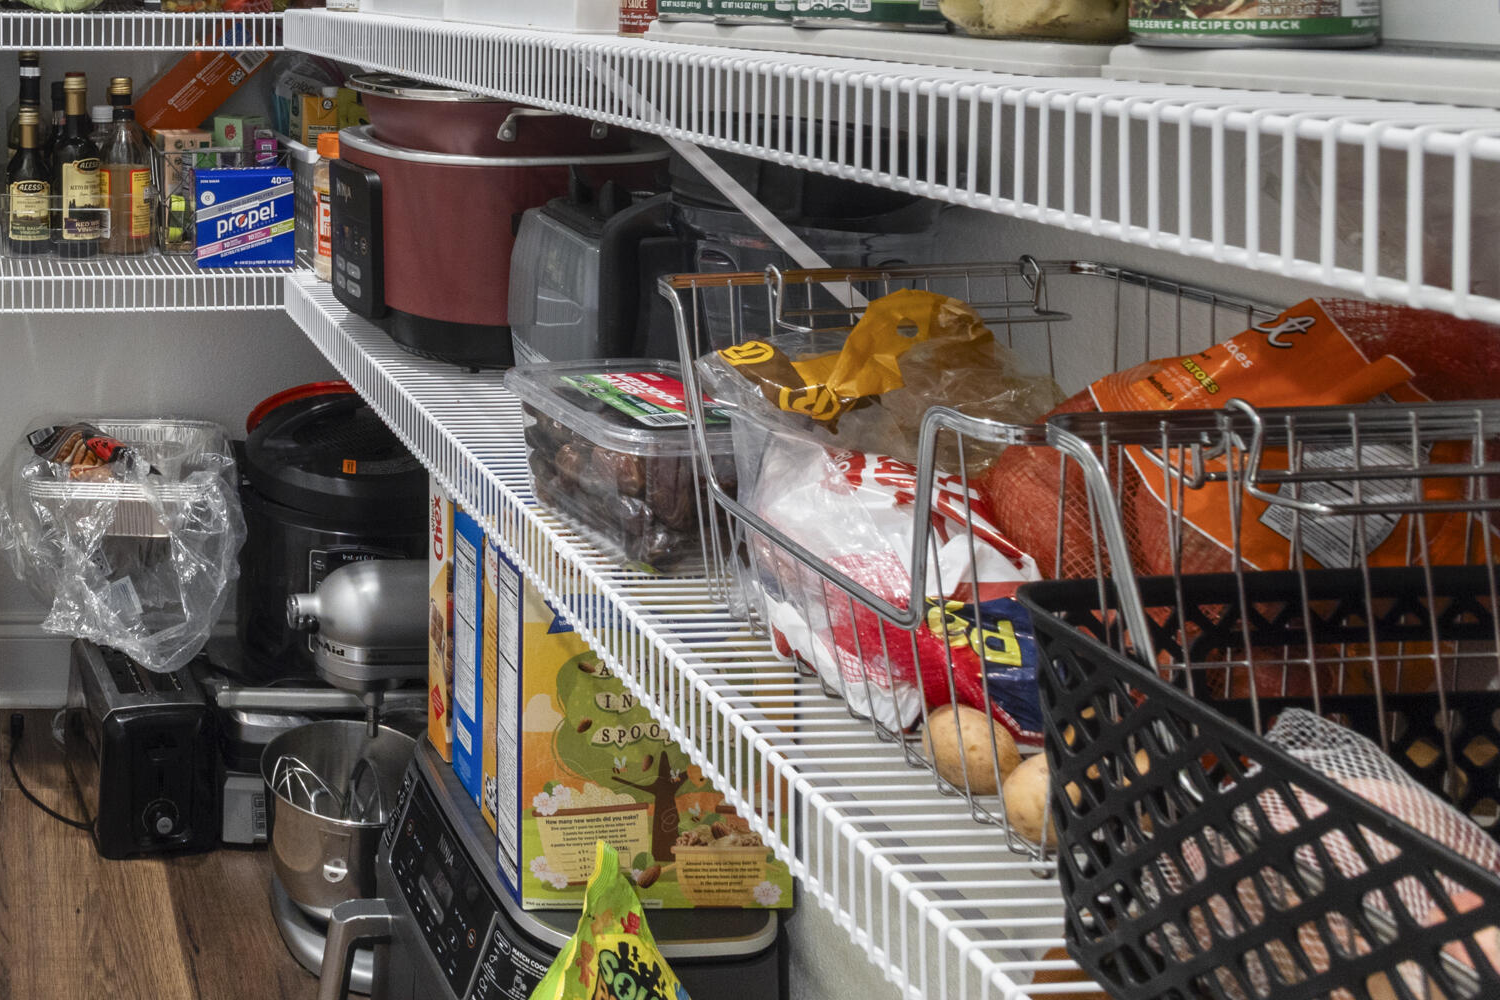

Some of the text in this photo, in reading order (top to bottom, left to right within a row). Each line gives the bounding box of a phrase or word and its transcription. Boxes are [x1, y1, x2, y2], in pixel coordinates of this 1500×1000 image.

[628, 0, 648, 9] SAUCE
[1182, 20, 1300, 30] RECIPE ON BACK
[217, 201, 275, 238] propel
[434, 495, 444, 561] Chex
